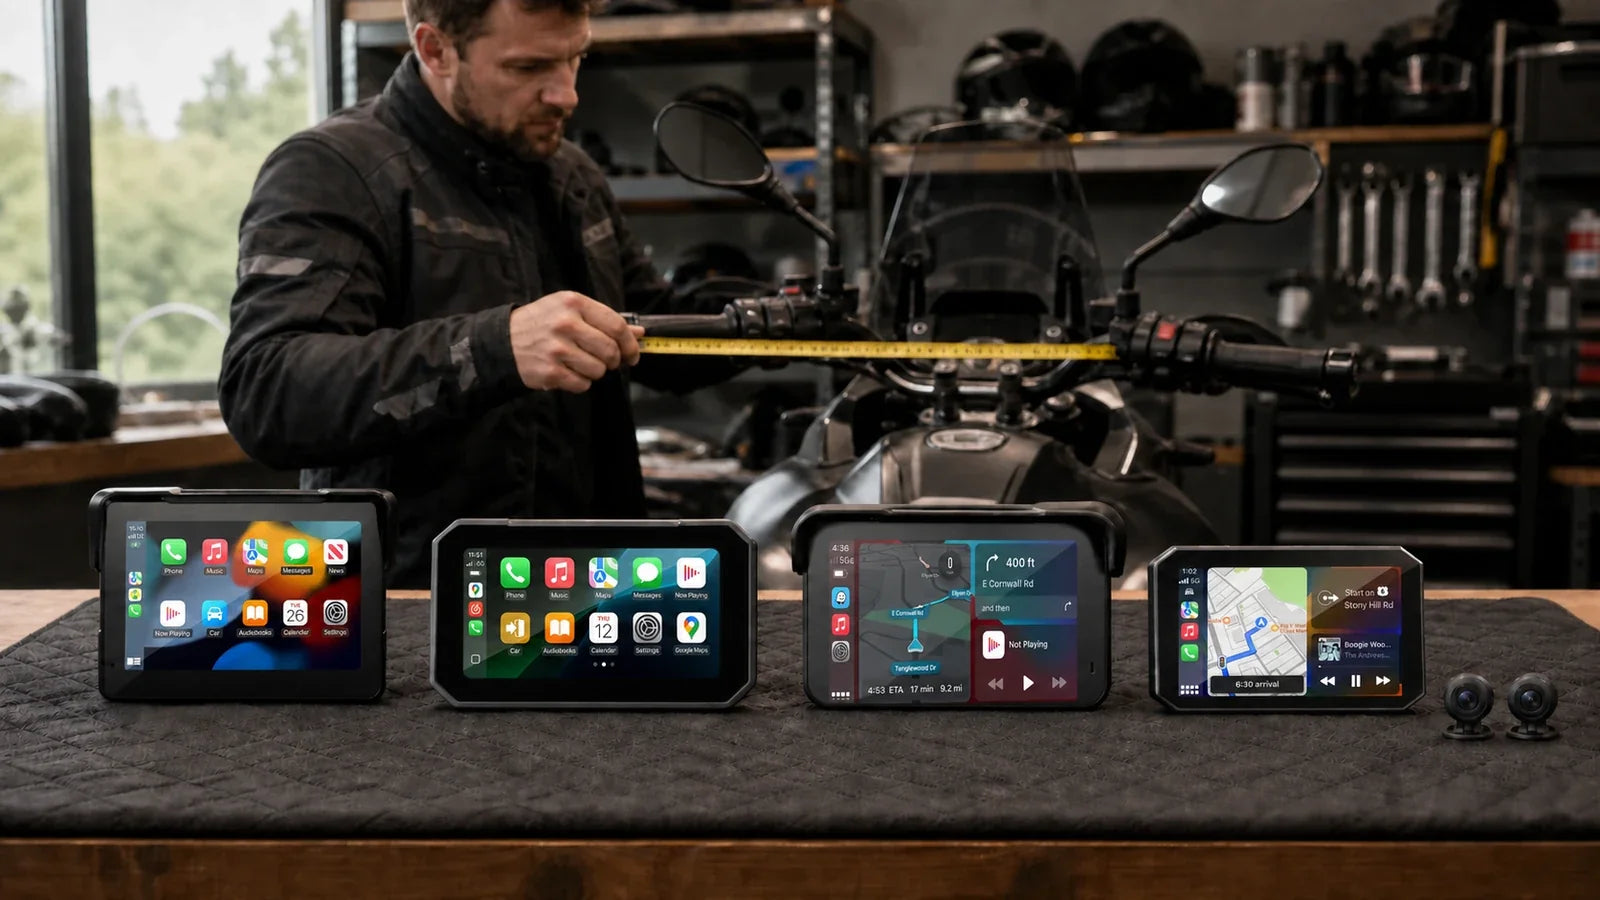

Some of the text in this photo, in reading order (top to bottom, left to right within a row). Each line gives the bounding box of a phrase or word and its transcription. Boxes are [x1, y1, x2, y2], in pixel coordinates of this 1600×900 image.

[947, 557, 952, 569] 0
[1006, 557, 1035, 568] 400 ft
[989, 579, 1022, 588] Cornwall
[1024, 579, 1034, 588] Rd
[1344, 601, 1367, 610] Stony
[287, 609, 304, 622] 26
[594, 623, 612, 638] 12
[1023, 640, 1048, 649] Playing
[895, 664, 928, 673] Tanglewood
[920, 685, 934, 693] min
[940, 685, 952, 693] 9.2
[953, 684, 962, 692] mi
